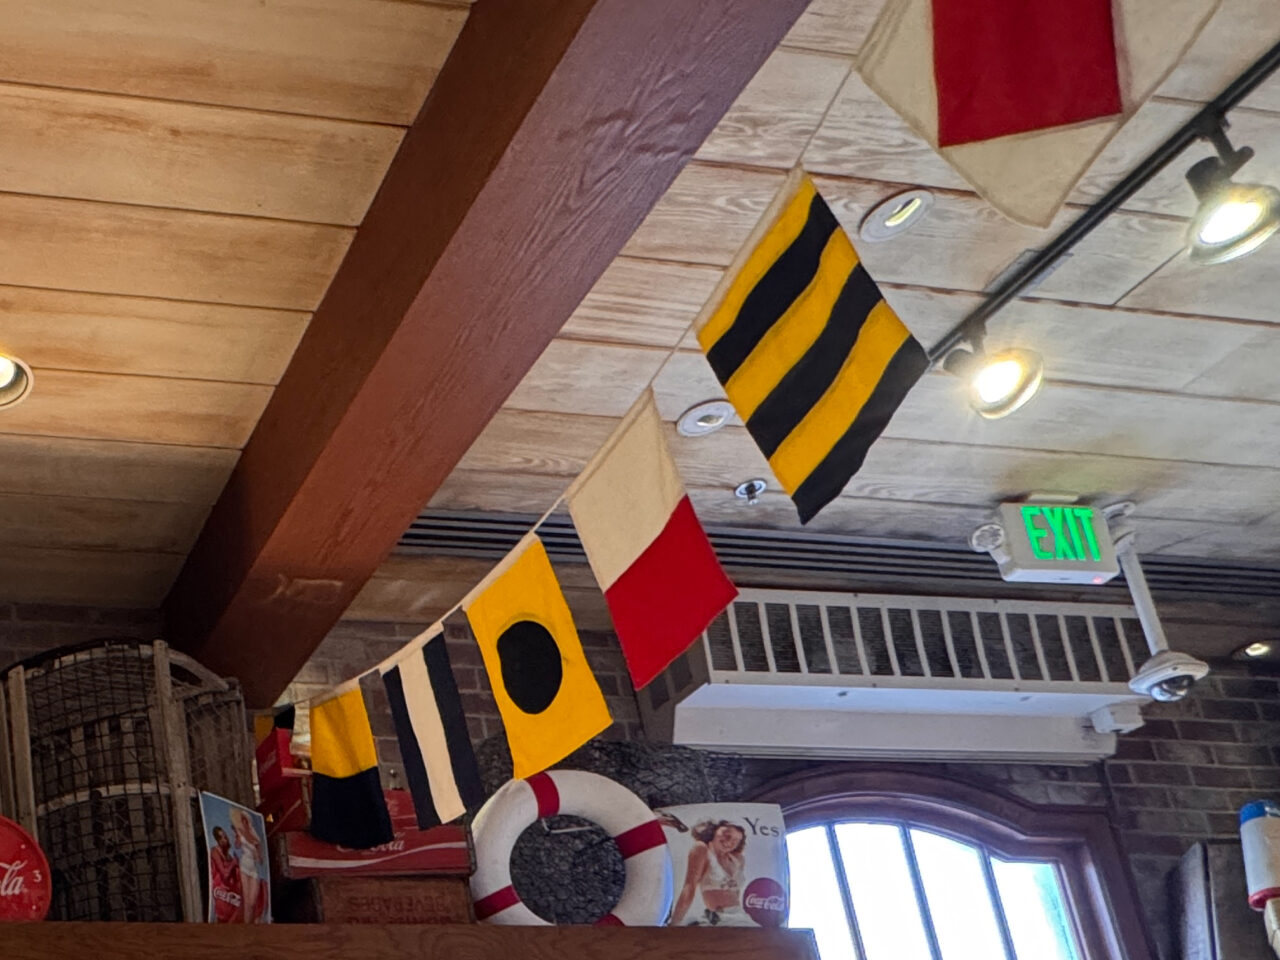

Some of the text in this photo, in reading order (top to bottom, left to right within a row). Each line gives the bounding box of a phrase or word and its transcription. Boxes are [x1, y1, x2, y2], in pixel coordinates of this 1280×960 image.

[1021, 505, 1102, 562] EXIT
[743, 816, 780, 838] Yes
[32, 869, 43, 883] 3
